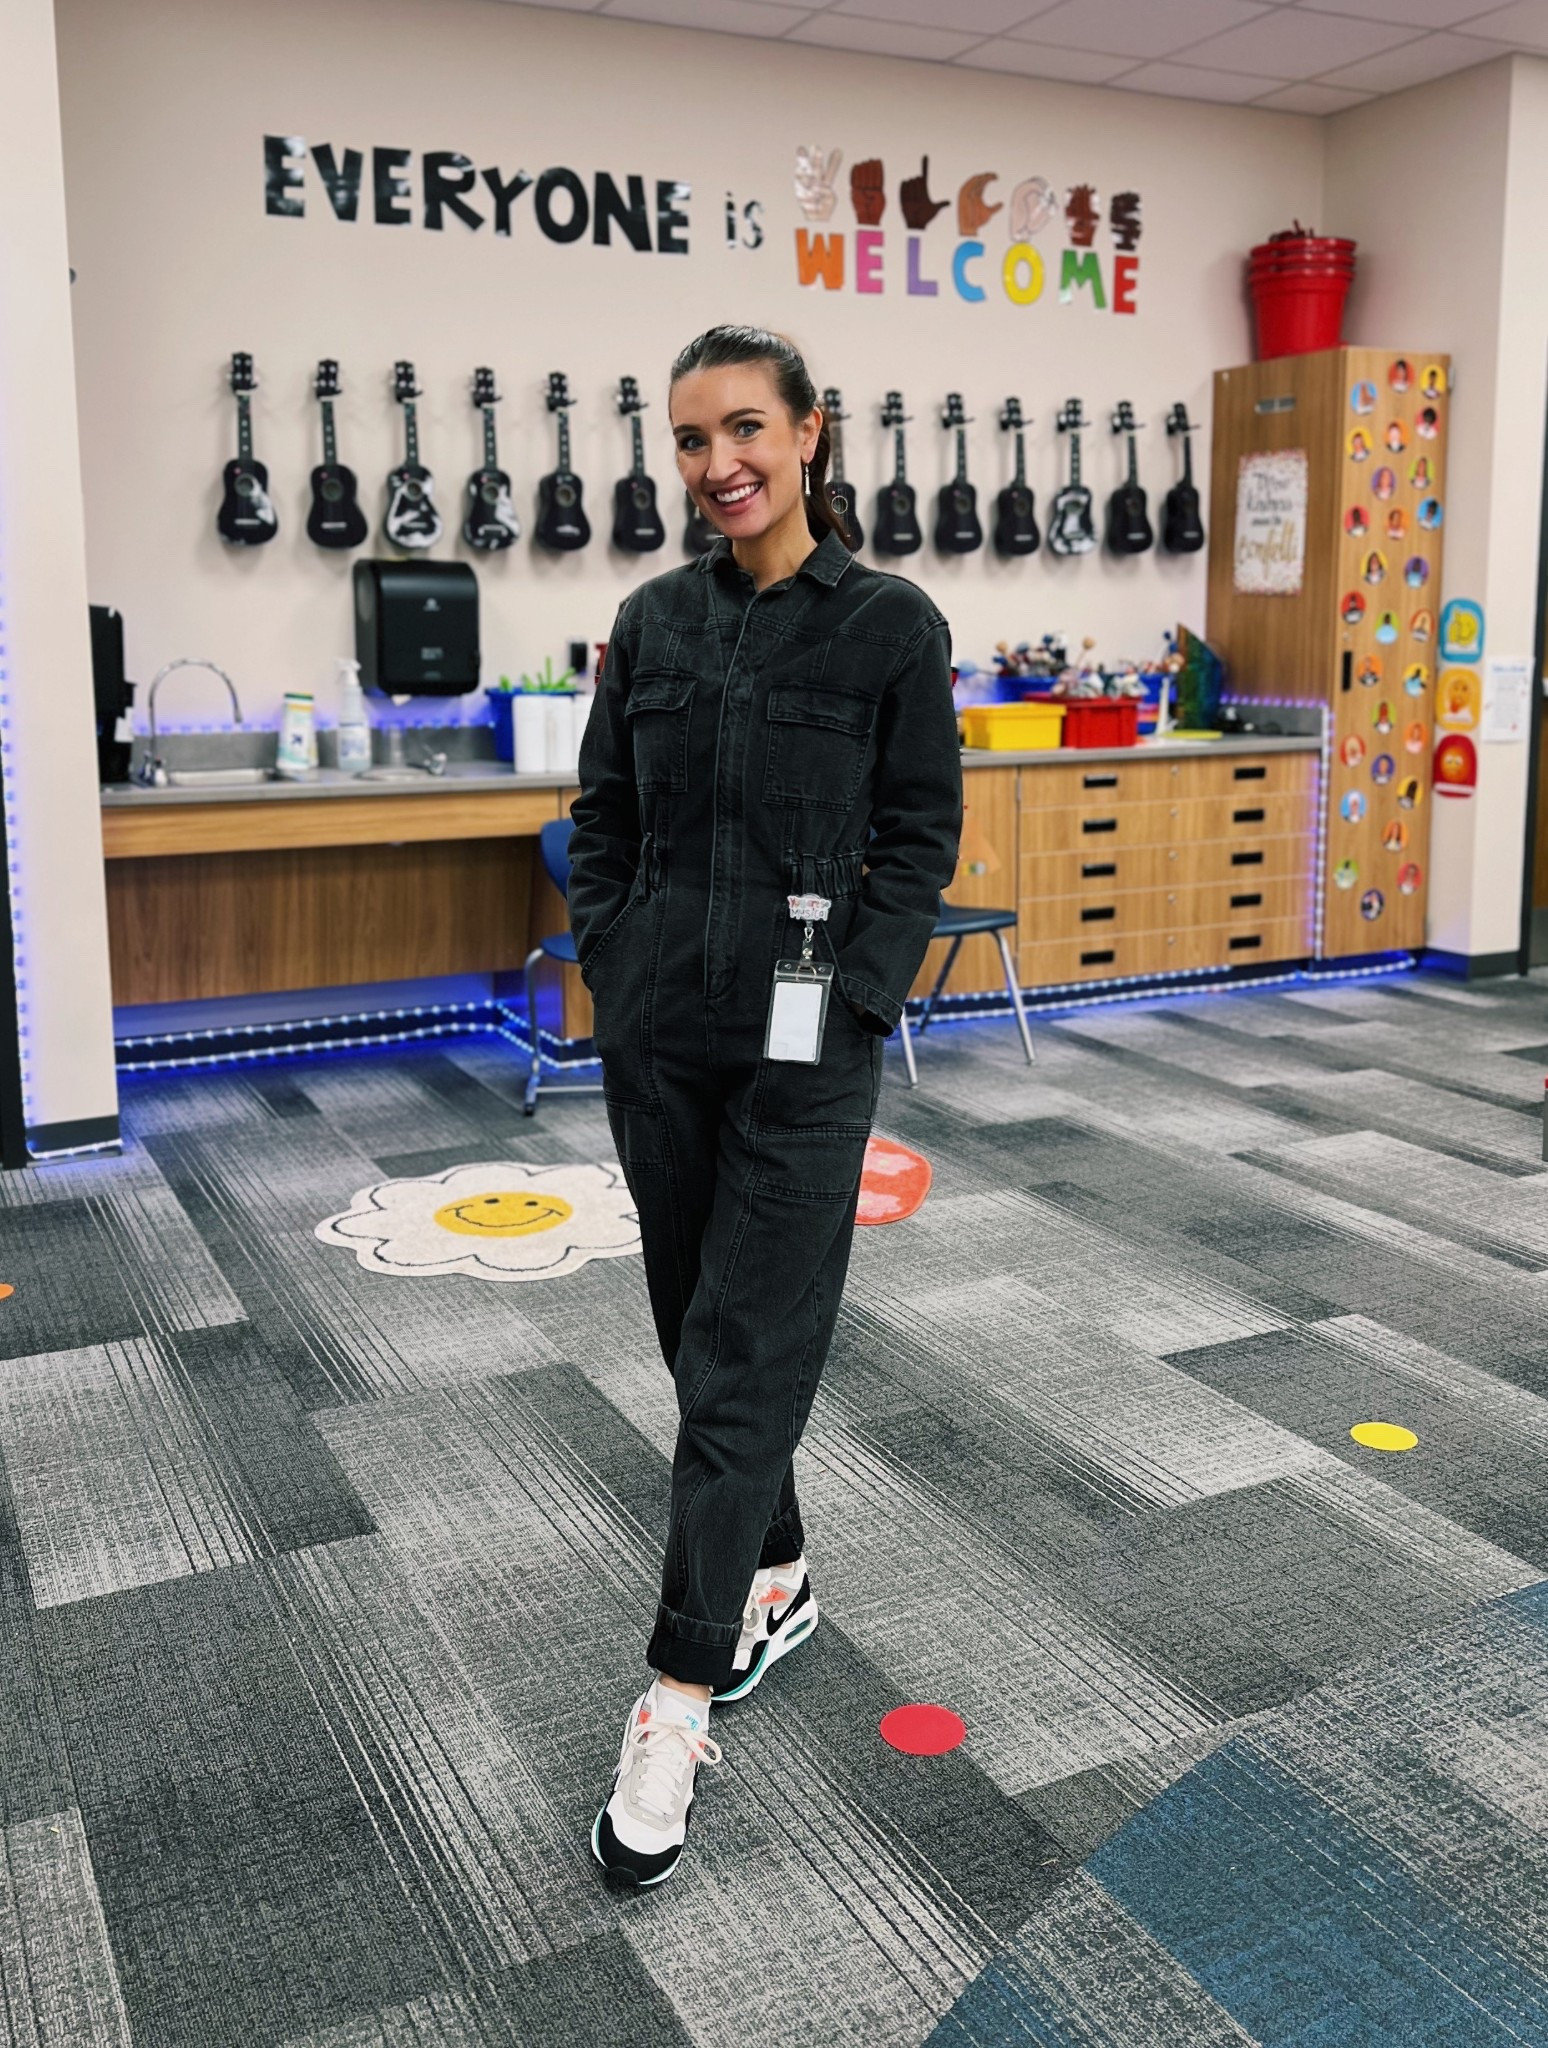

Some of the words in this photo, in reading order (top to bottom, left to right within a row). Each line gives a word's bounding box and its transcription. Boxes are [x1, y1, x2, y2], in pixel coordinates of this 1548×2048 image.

[263, 135, 691, 254] EVERYONE
[726, 191, 764, 249] is
[796, 228, 1140, 314] WELCOME
